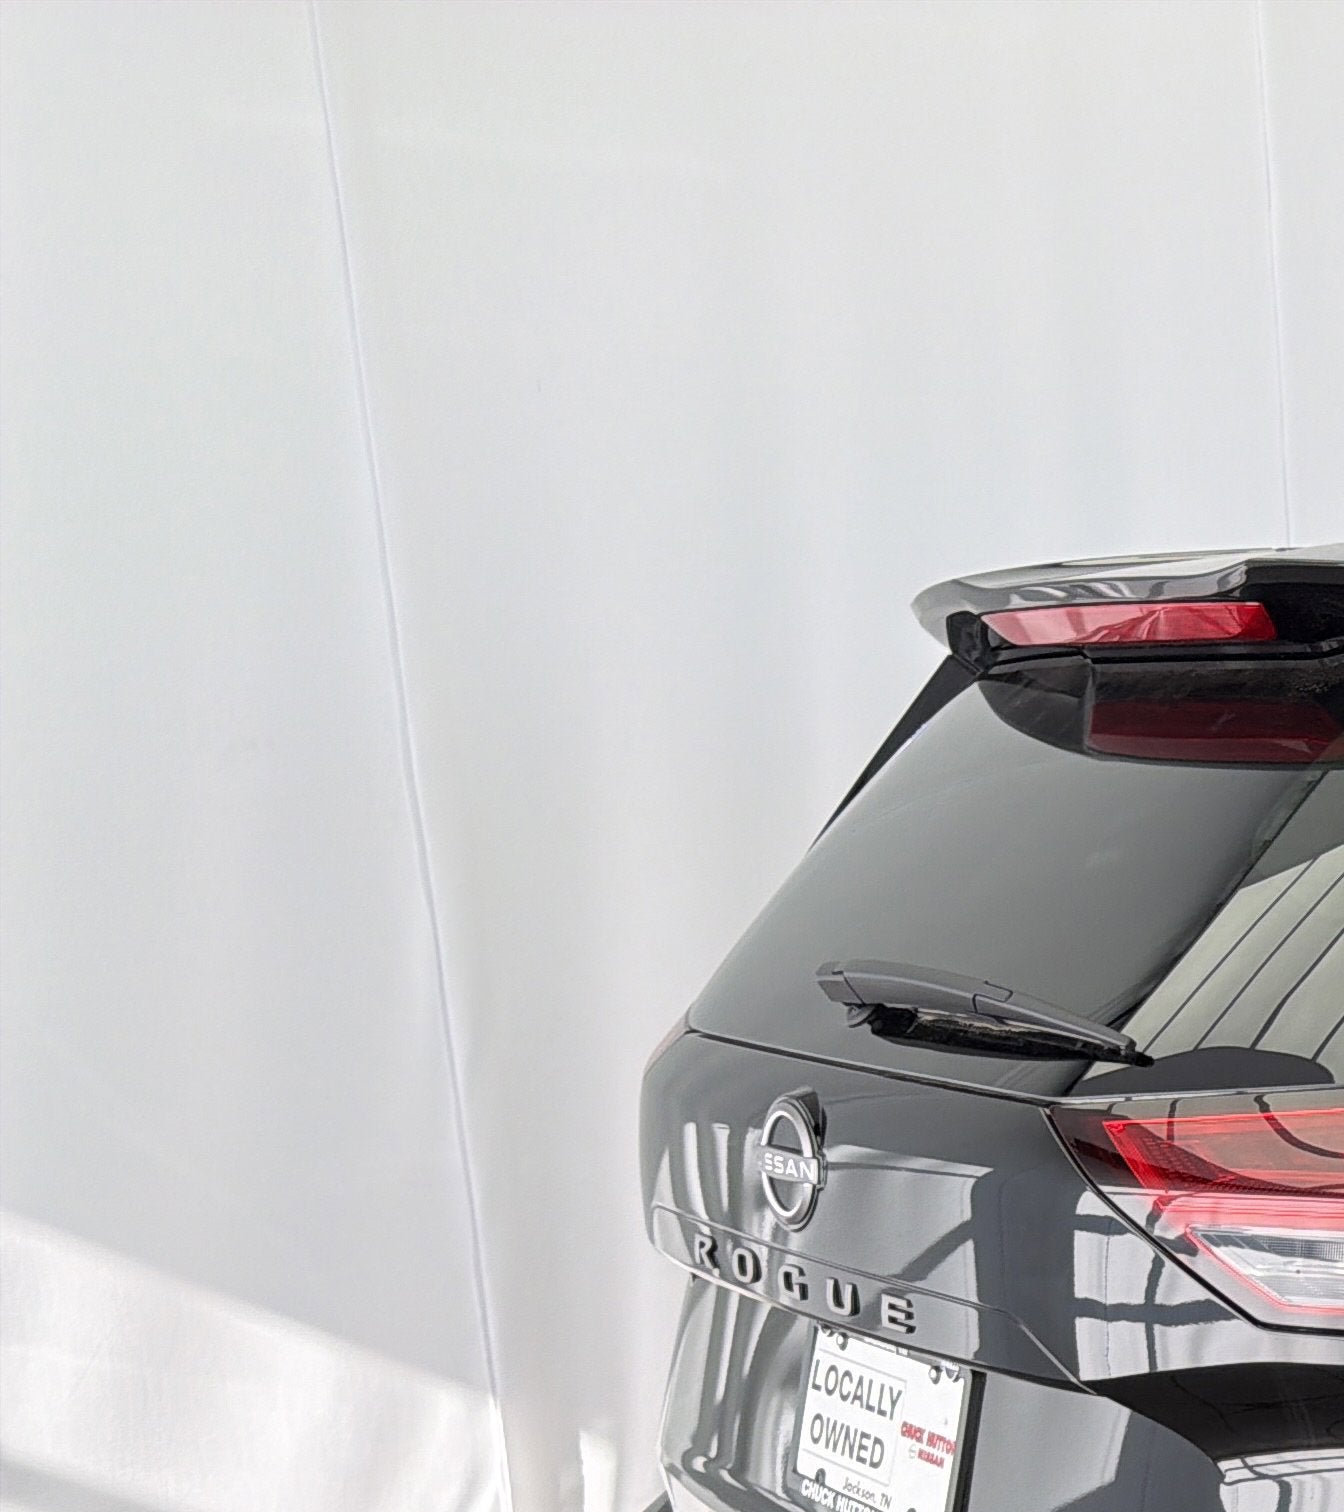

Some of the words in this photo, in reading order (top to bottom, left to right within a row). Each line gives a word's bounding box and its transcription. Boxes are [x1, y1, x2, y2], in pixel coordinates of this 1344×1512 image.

[762, 1151, 816, 1181] SSAN
[694, 1233, 916, 1334] ROGUE
[811, 1359, 902, 1421] LOCALLY
[810, 1413, 885, 1469] OWNED
[800, 1479, 835, 1509] CHUCK
[880, 1493, 893, 1510] TN
